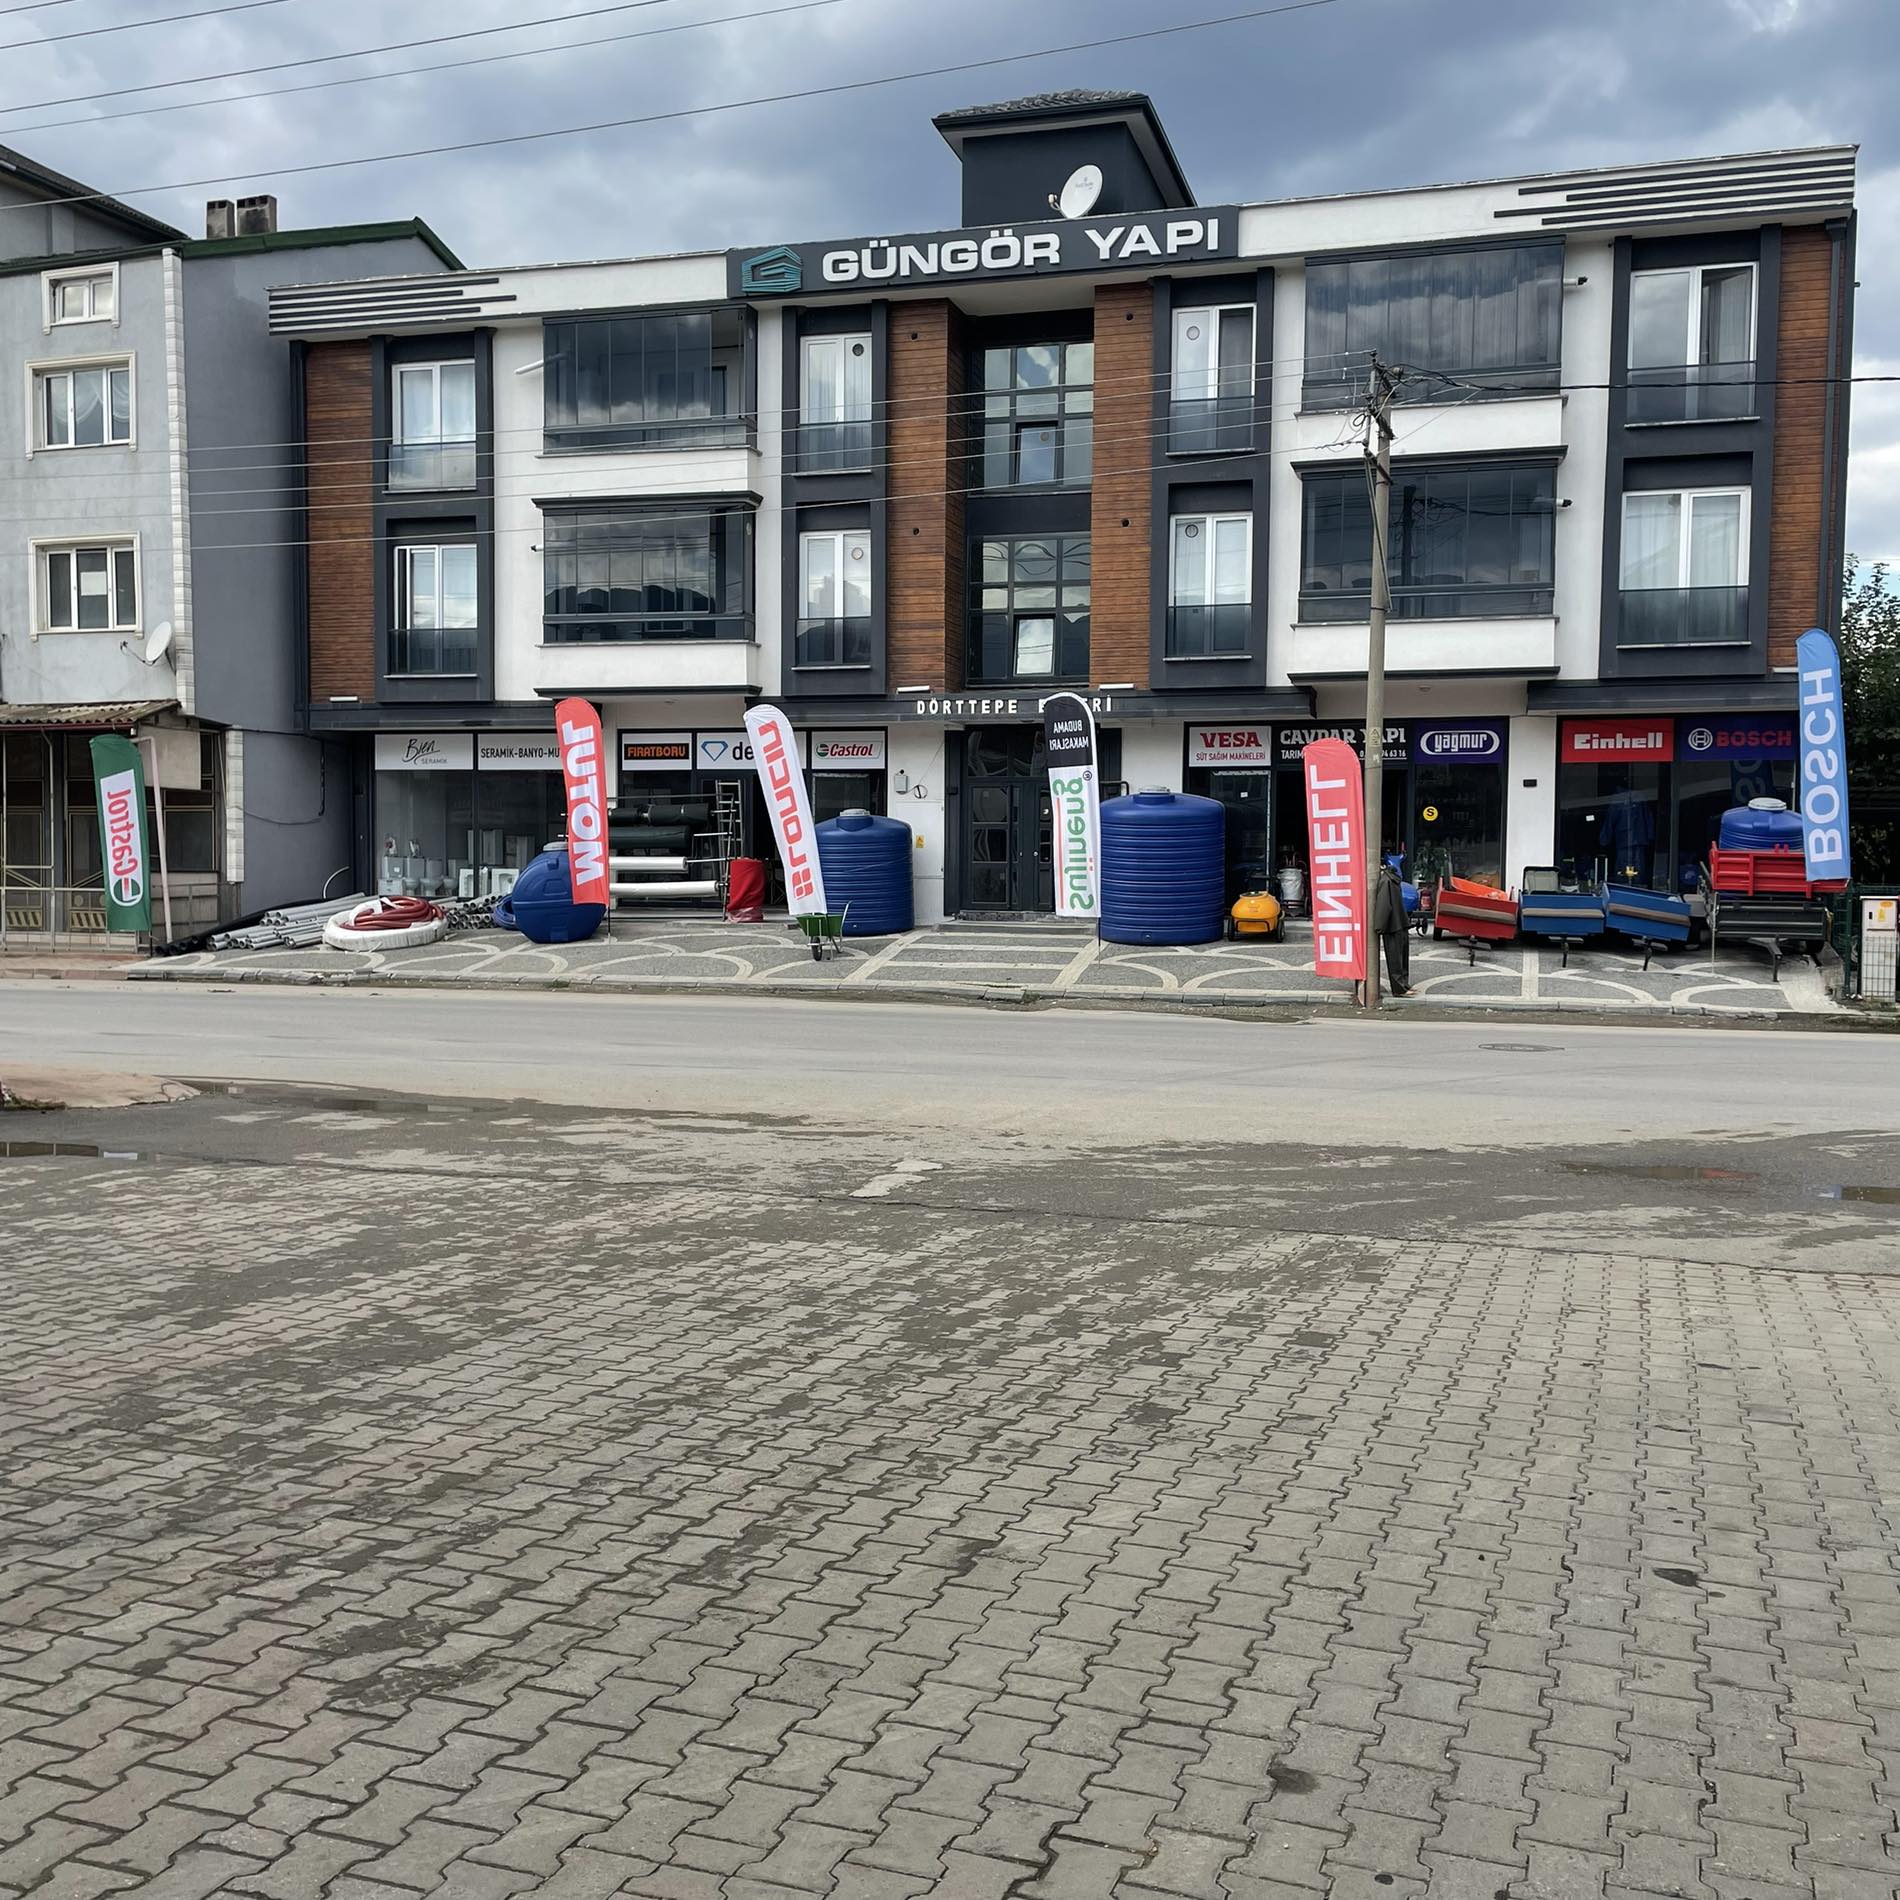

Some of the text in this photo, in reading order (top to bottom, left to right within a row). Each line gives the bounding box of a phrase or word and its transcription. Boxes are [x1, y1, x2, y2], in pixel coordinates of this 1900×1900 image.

[822, 218, 1220, 283] GÜNGÖR YAPI
[916, 694, 1112, 715] DÖRTTEPE ERİ
[1200, 731, 1262, 748] VESA
[1573, 732, 1663, 750] Einhell
[1716, 730, 1792, 748] BOSCH
[402, 738, 441, 764] Bien
[480, 746, 560, 759] SERAMİK-BANYO-MU
[627, 745, 686, 758] FIRATBORU
[830, 743, 874, 757] Castrol
[1196, 751, 1208, 761] SÜT
